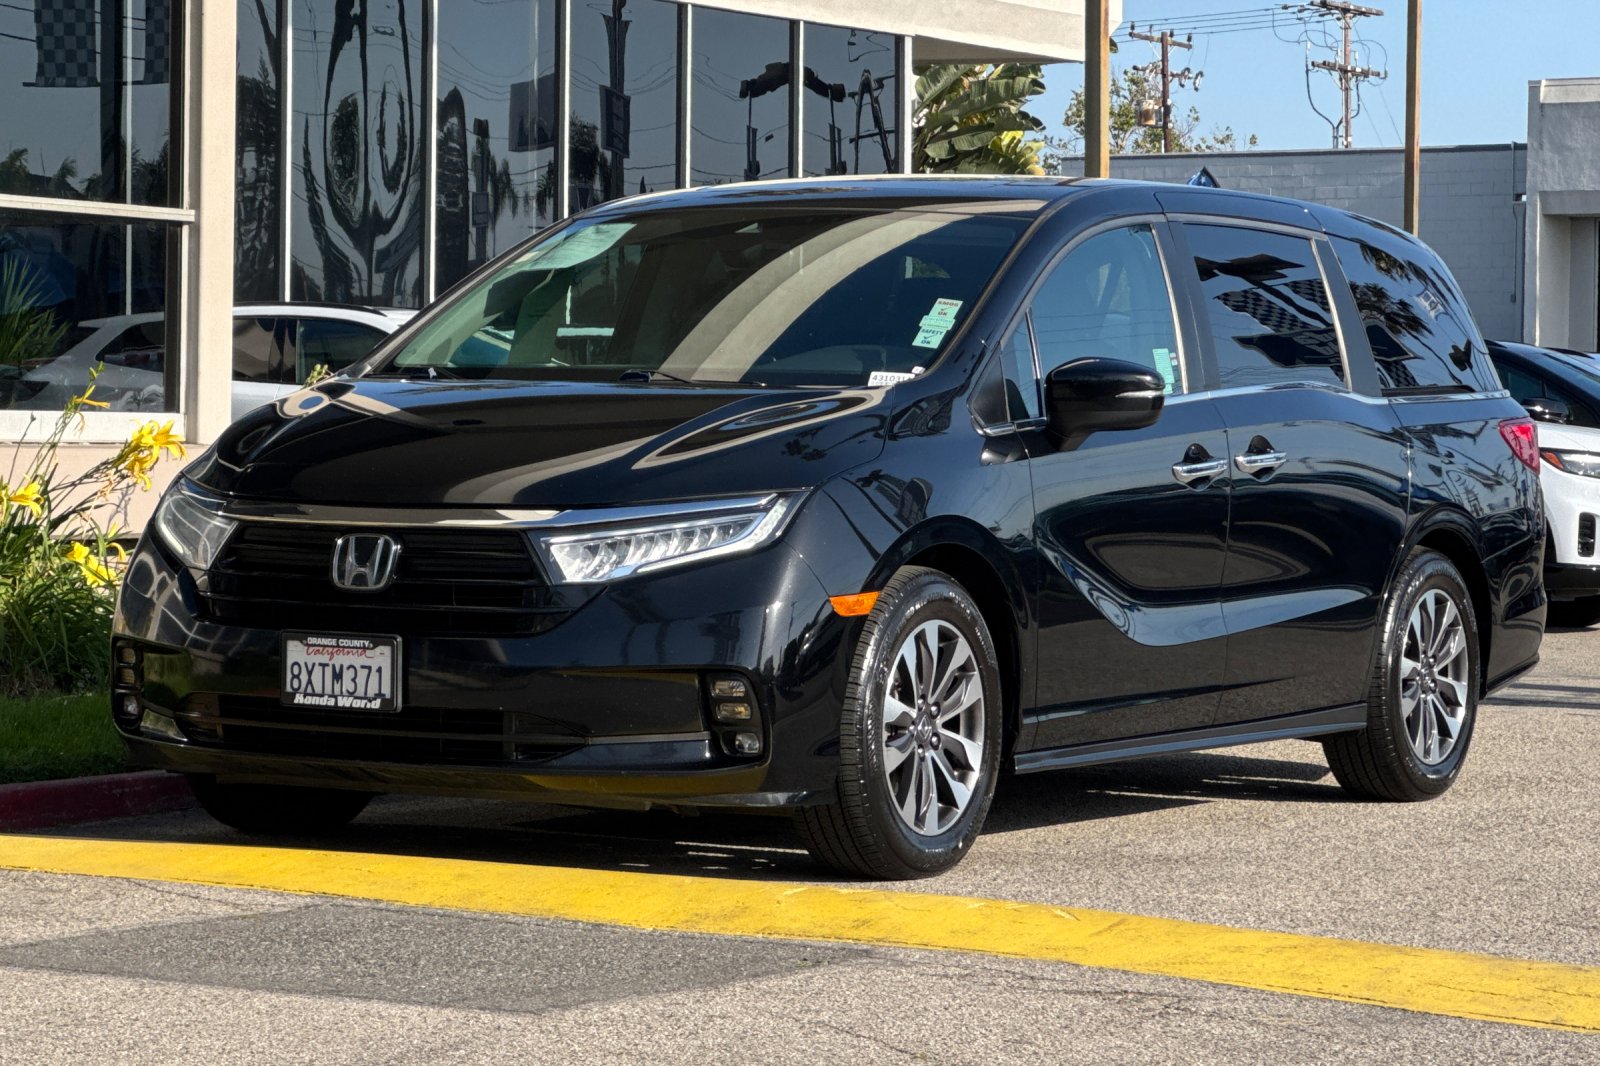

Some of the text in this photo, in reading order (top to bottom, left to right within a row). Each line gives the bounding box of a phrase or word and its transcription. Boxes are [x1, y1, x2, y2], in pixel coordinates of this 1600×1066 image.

[307, 637, 370, 648] ORANGE COUNTY
[305, 646, 375, 661] California
[290, 661, 386, 698] 8XTM371
[293, 693, 382, 709] Honda World
